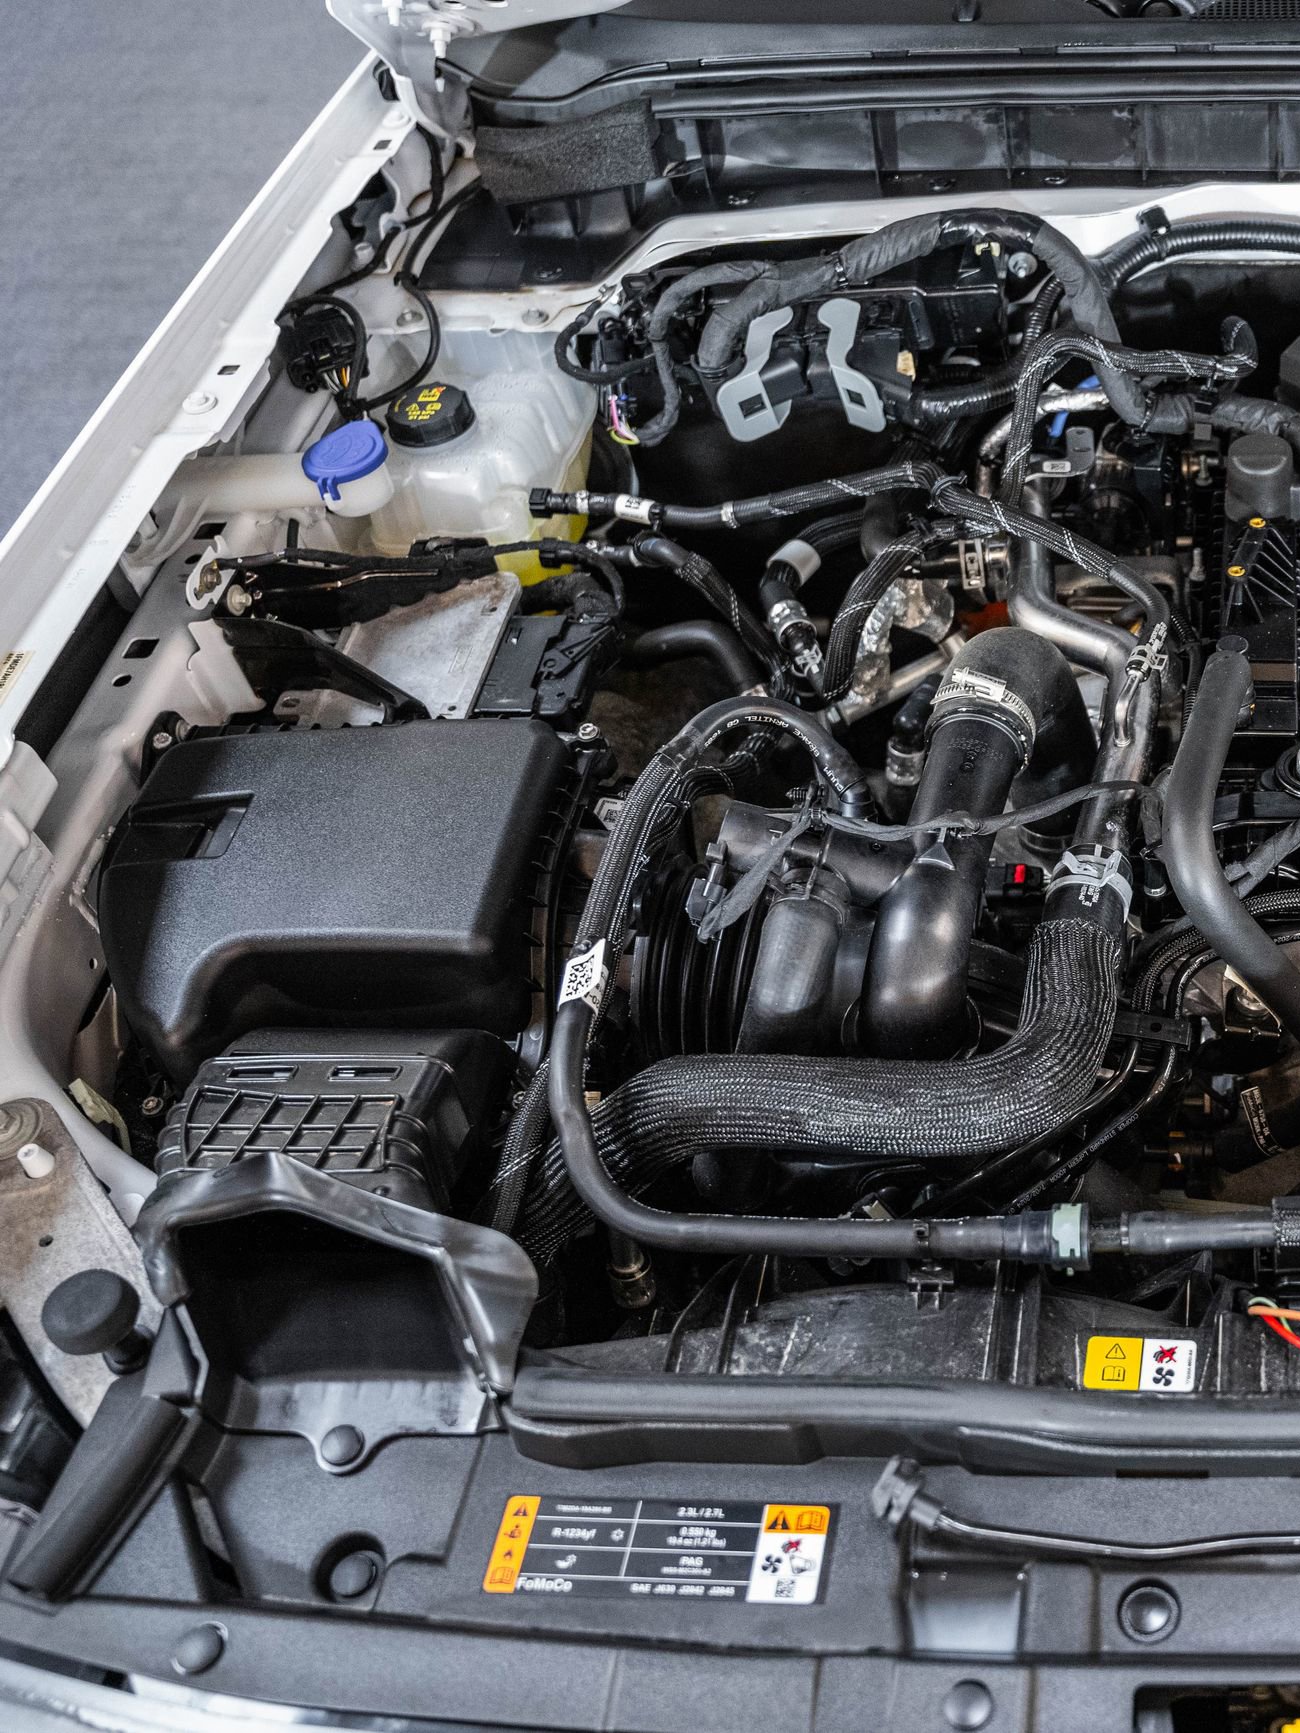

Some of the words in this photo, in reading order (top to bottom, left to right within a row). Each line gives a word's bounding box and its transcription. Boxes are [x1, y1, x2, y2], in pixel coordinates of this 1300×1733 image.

[744, 715, 789, 729] ARNITEL
[793, 728, 821, 758] BRAKE
[1118, 1112, 1139, 1131] COOPER
[1089, 1129, 1117, 1152] STANDARD
[1068, 1149, 1089, 1169] LoPERM
[551, 1527, 597, 1541] R-1234yf
[680, 1526, 704, 1537] 0.550
[705, 1528, 717, 1538] kg
[680, 1556, 704, 1567] PAG
[516, 1577, 572, 1593] FoMoCo
[630, 1583, 651, 1594] SAE
